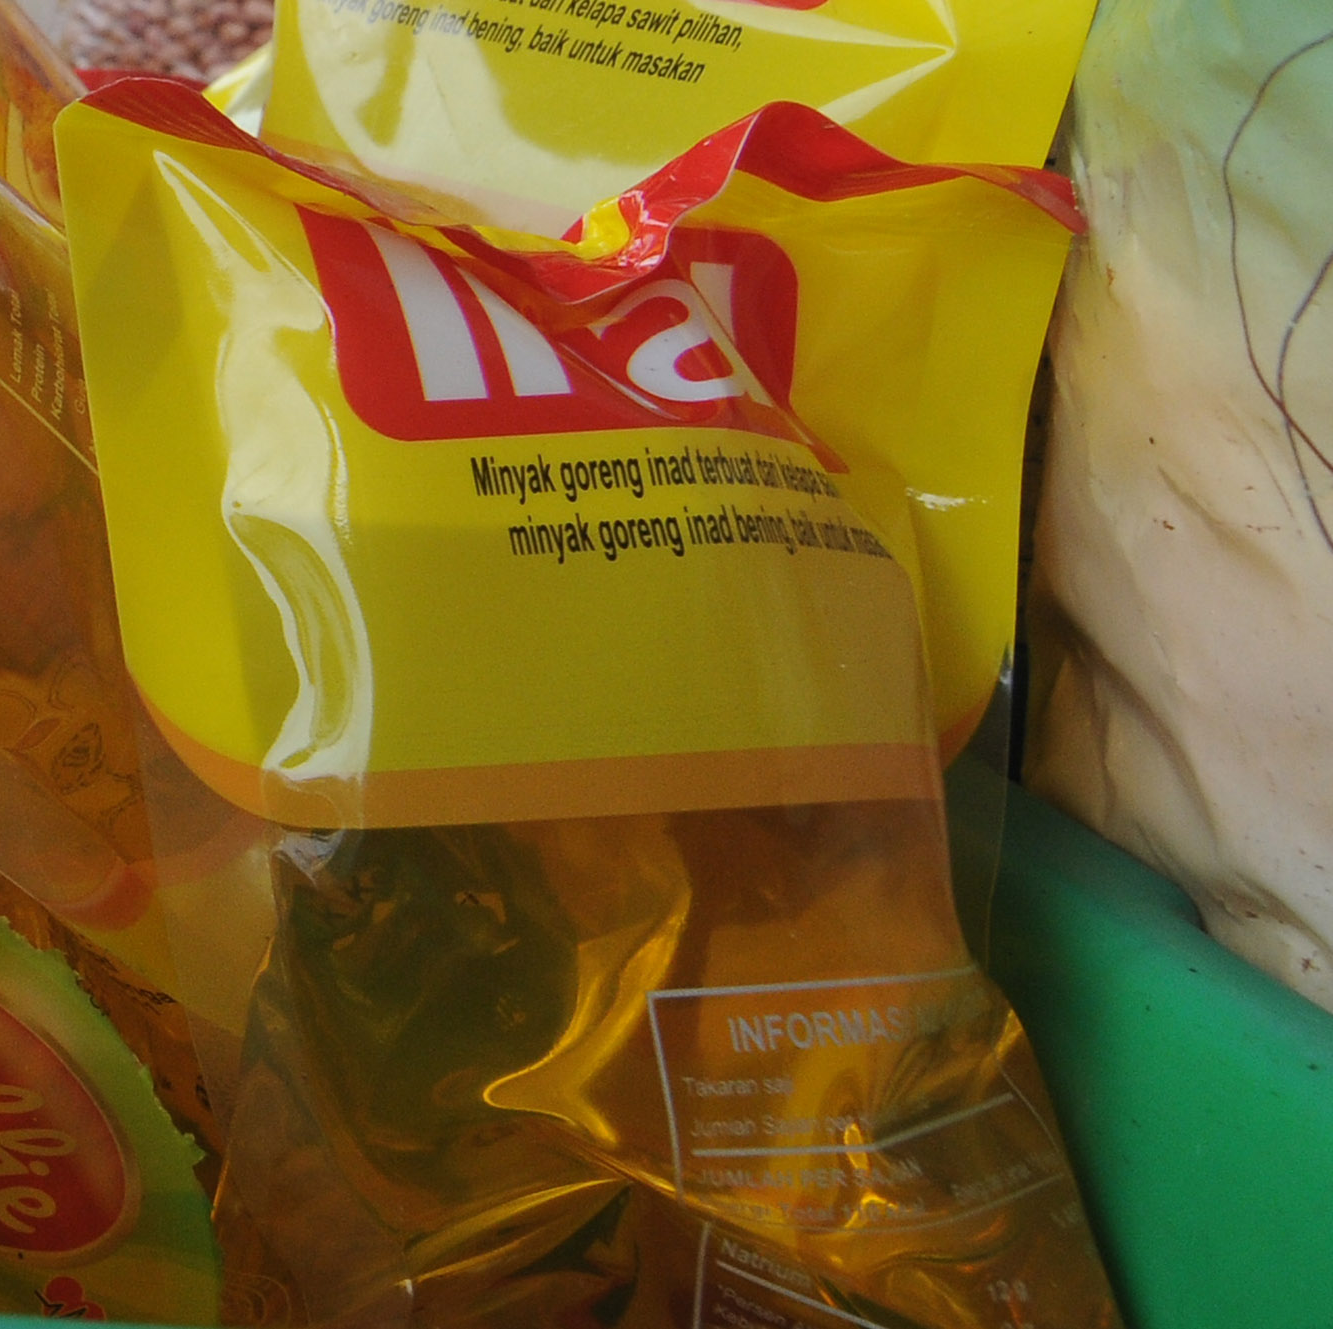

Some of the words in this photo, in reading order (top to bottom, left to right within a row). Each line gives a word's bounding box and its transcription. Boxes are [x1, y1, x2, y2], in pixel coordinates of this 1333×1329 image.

[431, 5, 465, 37] inad
[466, 13, 524, 54] bening,
[528, 26, 567, 57] baik
[569, 37, 621, 68] untuk
[621, 49, 707, 84] masakan
[627, 4, 679, 37] sawit
[675, 10, 744, 52] pilihan,
[10, 328, 25, 383] Lemak
[32, 344, 45, 402] Protein
[471, 454, 557, 505] Minyak
[561, 456, 645, 502] goreng
[646, 447, 694, 487] inad
[696, 449, 755, 485] terbuat
[756, 454, 780, 488] dari
[508, 513, 596, 564] minyak
[598, 513, 685, 561] goreng
[684, 503, 735, 546] inad
